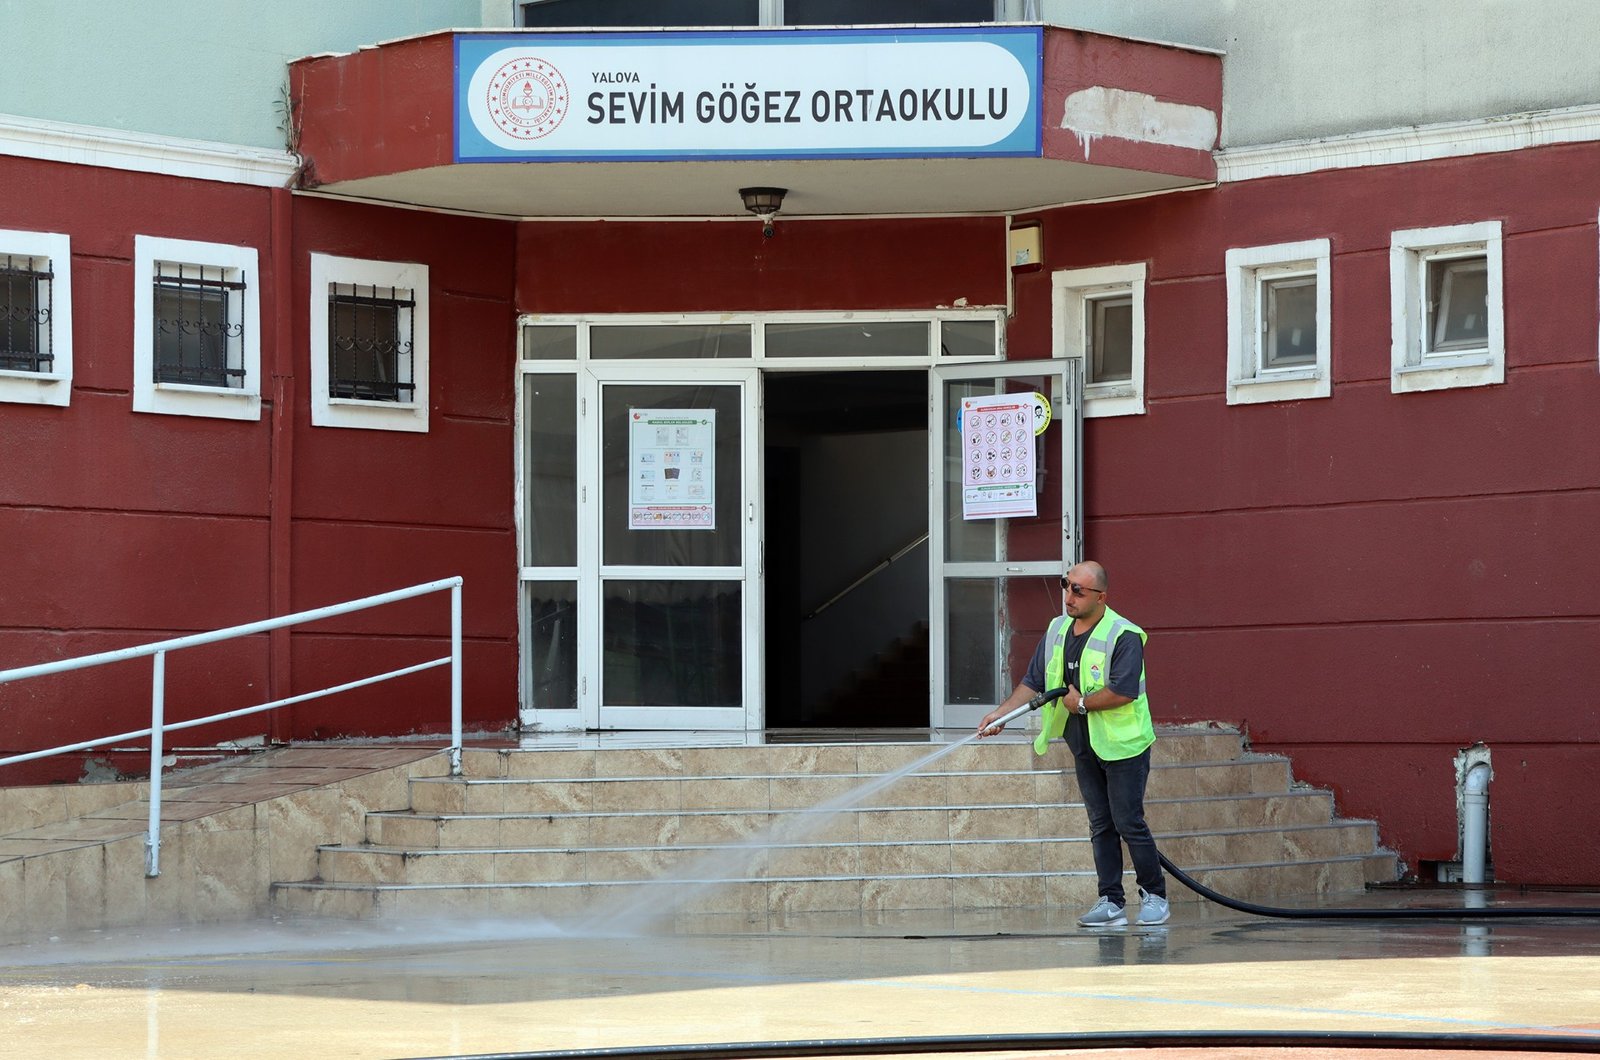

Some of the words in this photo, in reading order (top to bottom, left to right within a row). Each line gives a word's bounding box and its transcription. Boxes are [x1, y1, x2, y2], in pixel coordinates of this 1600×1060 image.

[592, 72, 639, 83] YALOVA
[587, 82, 684, 124] SEVİM
[696, 81, 800, 123] GÖĞEZ
[812, 88, 1008, 122] ORTAOKULU
